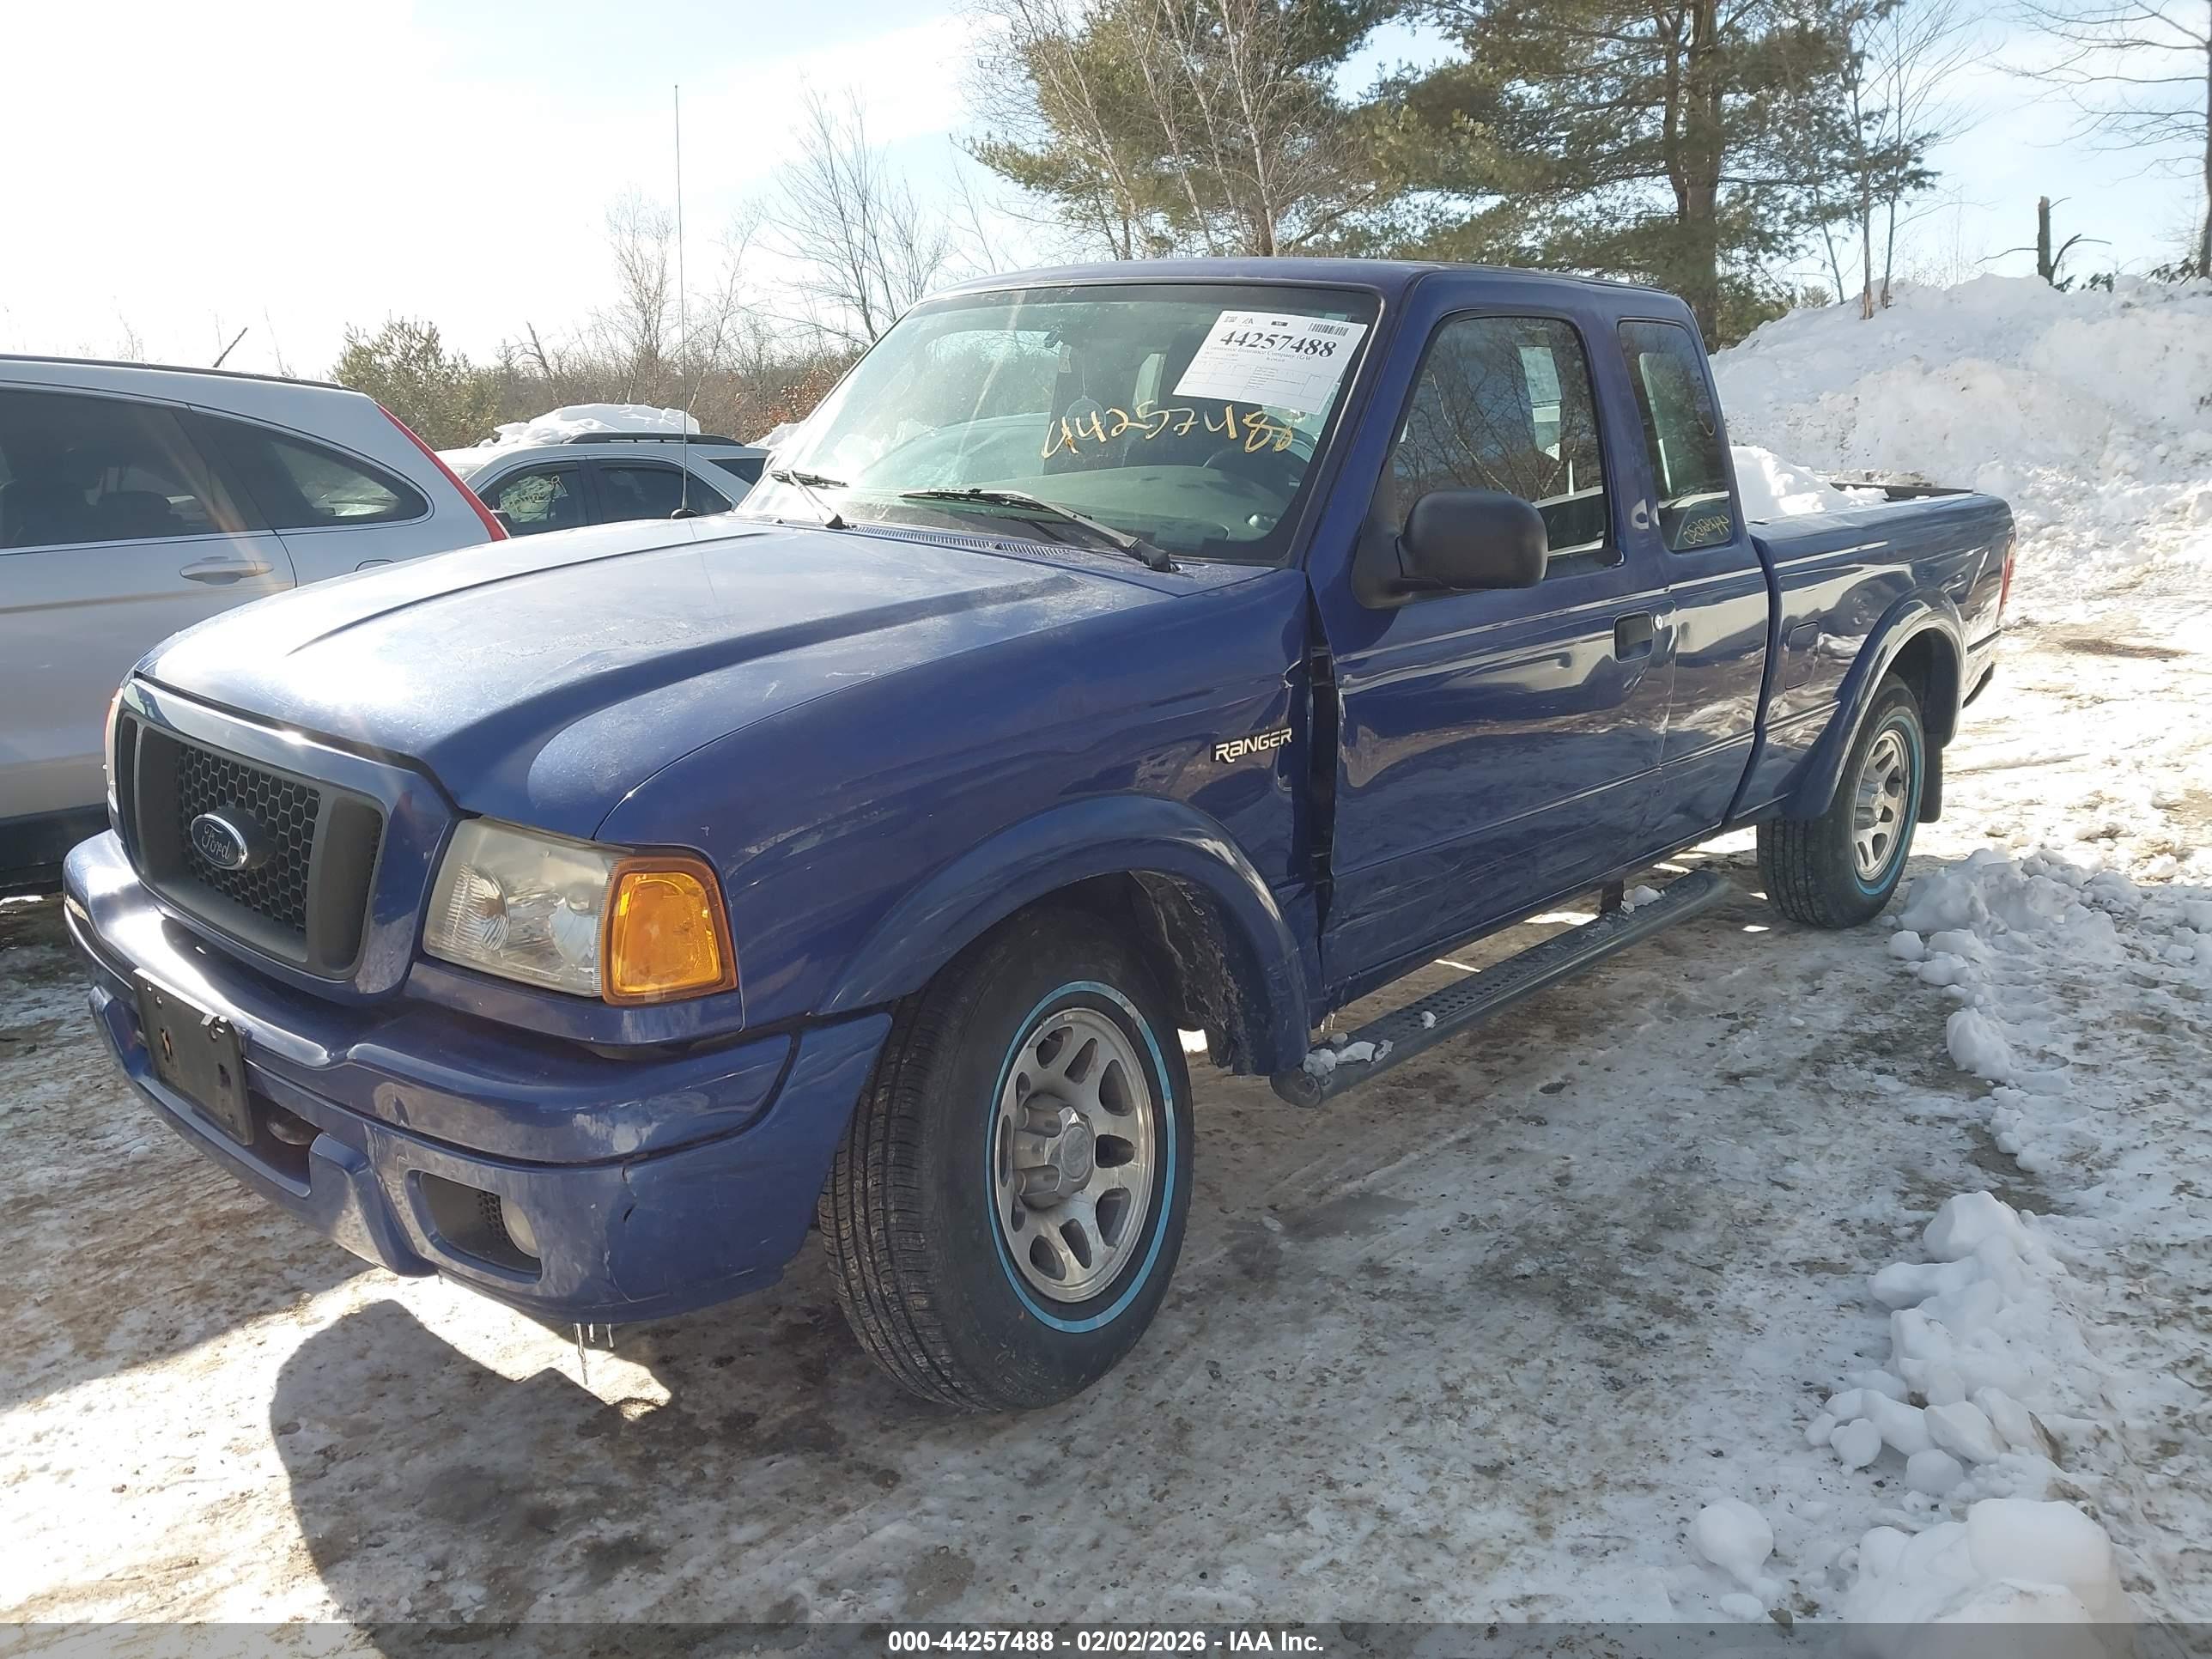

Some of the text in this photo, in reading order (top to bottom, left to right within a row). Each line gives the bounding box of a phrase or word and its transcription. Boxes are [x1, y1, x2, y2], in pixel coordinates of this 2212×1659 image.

[1220, 330, 1336, 357] 44257488
[1215, 727, 1292, 763] RANGER
[201, 823, 230, 860] Ford
